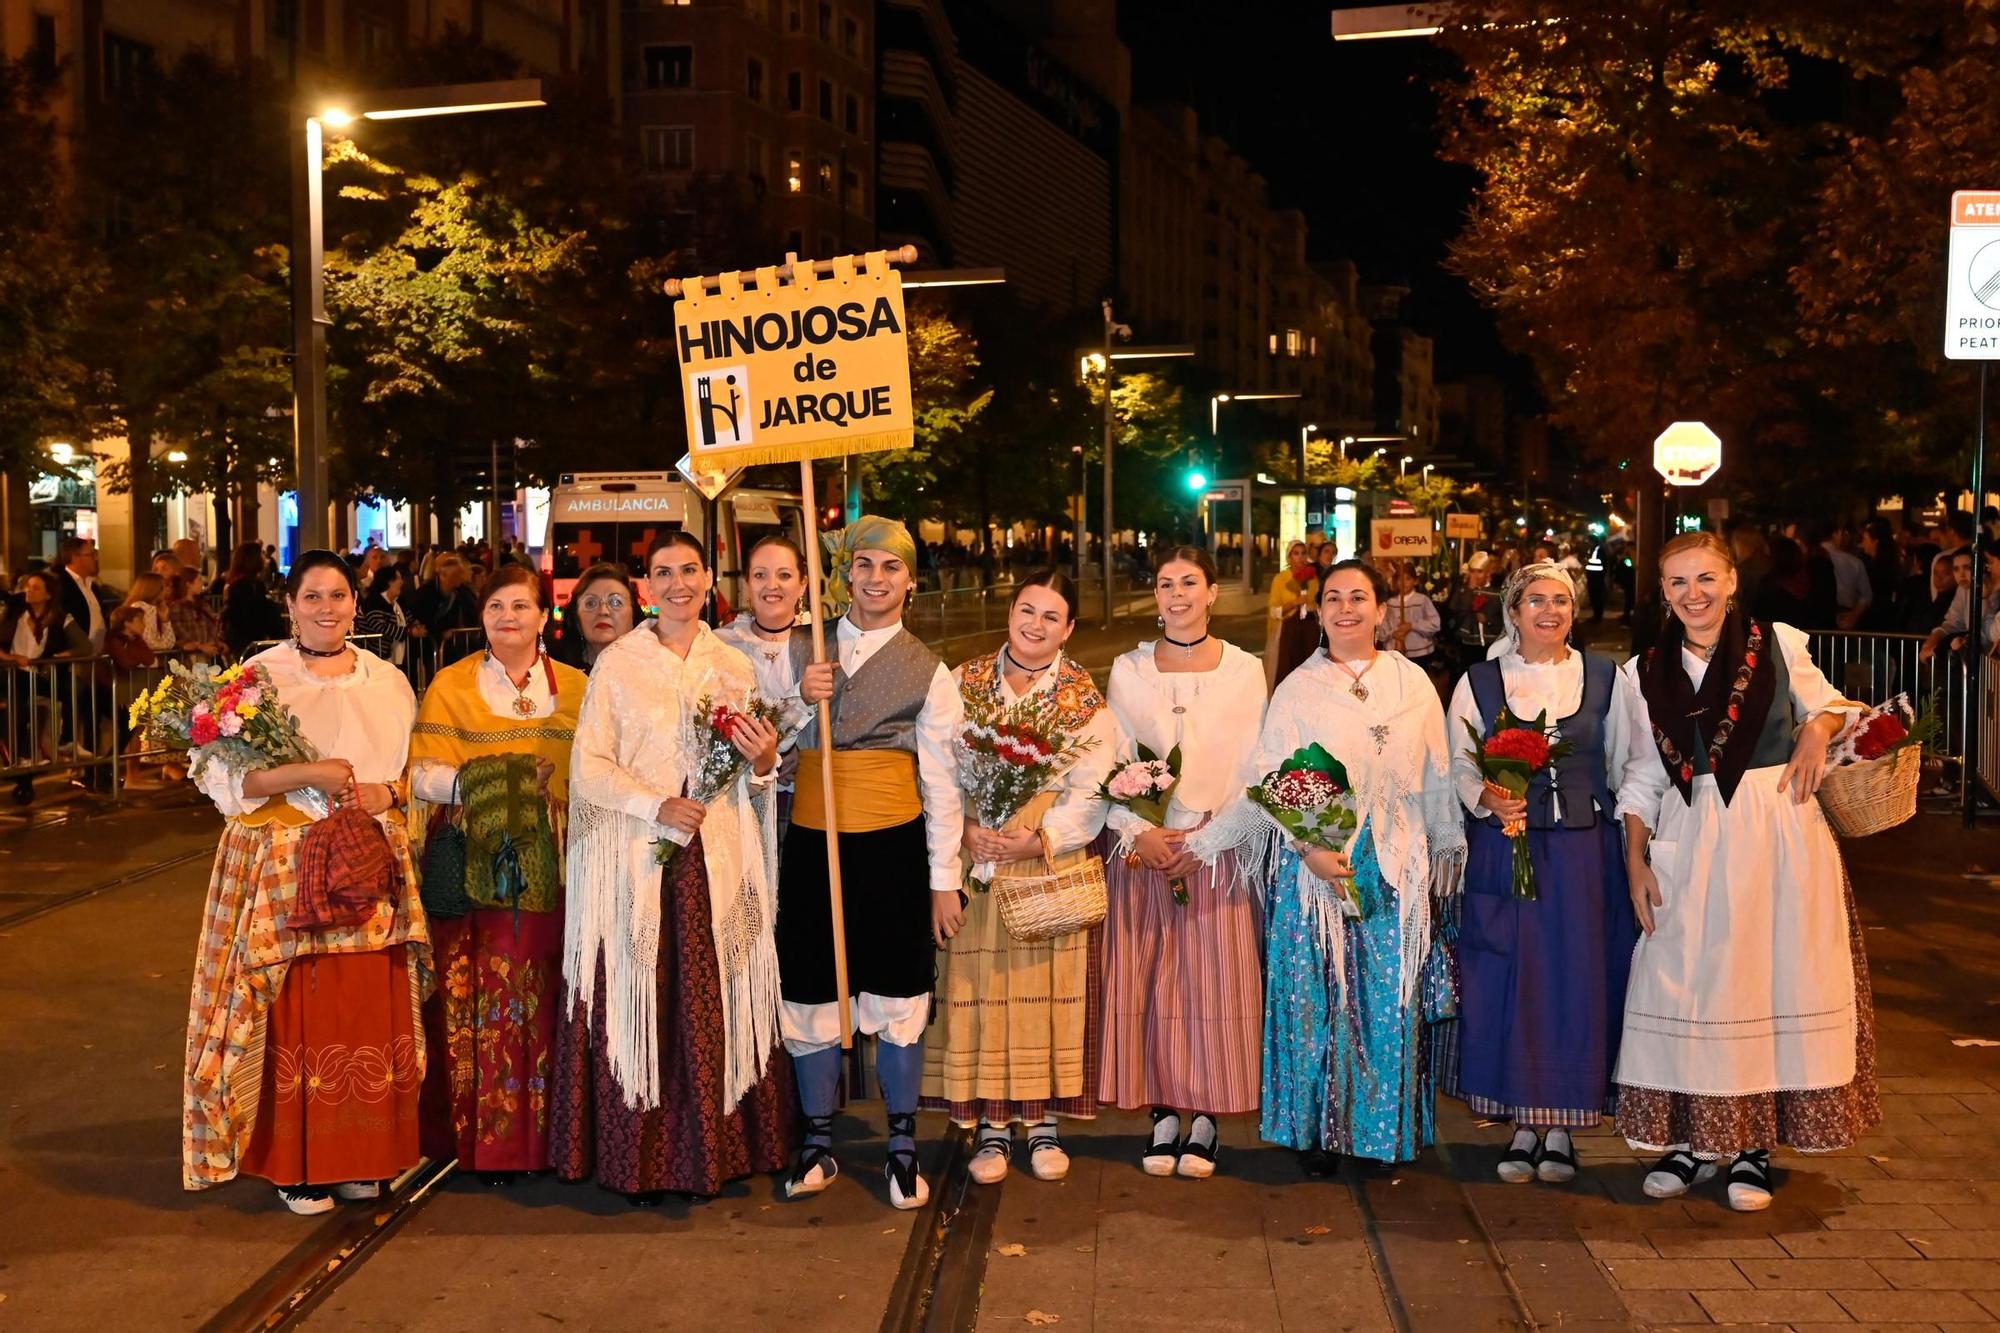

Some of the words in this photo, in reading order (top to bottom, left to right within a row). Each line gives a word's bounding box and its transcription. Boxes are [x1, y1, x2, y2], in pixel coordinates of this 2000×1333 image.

[678, 297, 901, 363] HINOJOSA
[794, 352, 836, 383] de
[759, 385, 892, 429] JARQUE
[567, 497, 669, 512] AMBULANCIA
